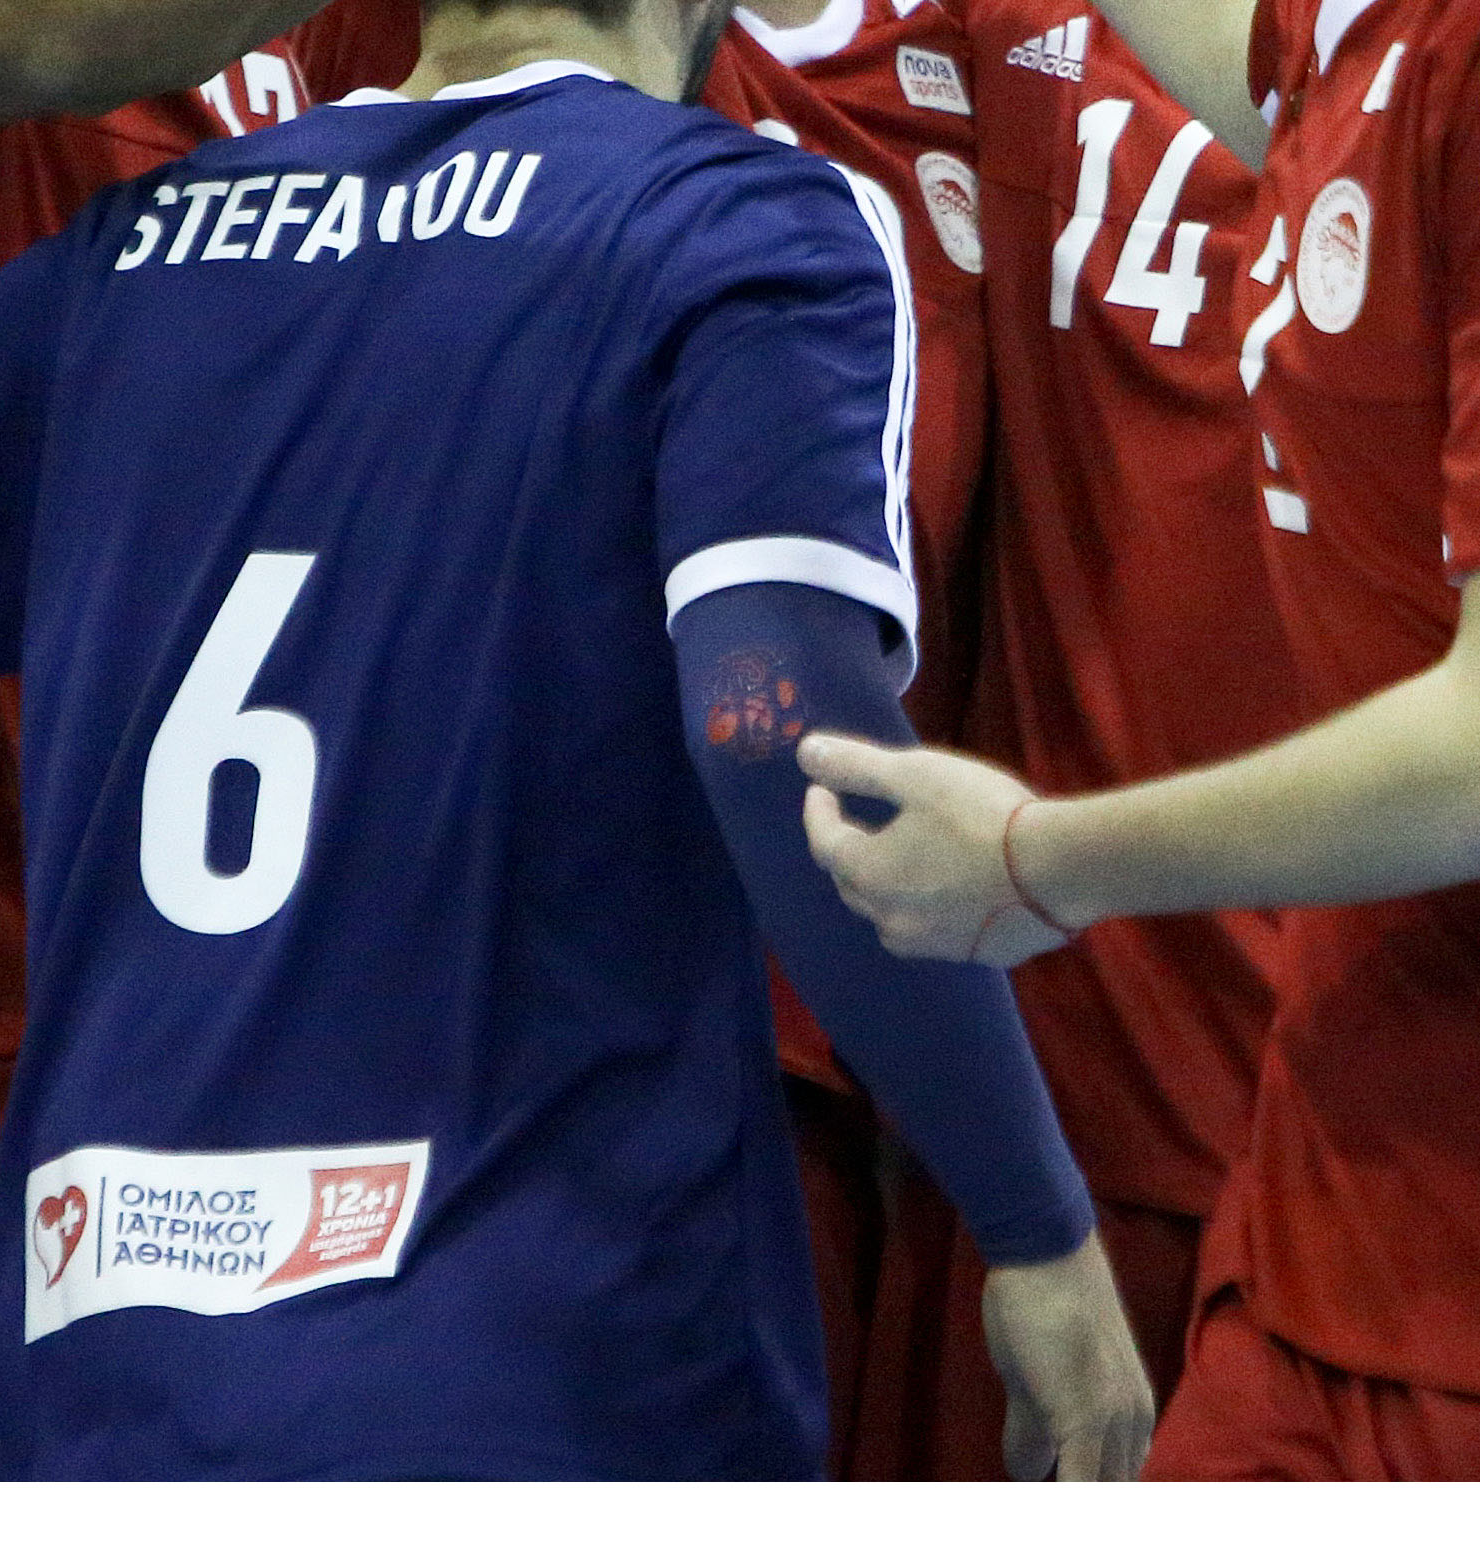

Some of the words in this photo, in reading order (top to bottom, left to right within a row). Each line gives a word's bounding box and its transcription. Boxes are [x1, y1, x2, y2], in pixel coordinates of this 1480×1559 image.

[904, 53, 953, 80] nova
[1006, 45, 1084, 83] adidas
[1049, 98, 1215, 348] 14
[139, 551, 319, 935] 6
[118, 1183, 258, 1216] ΟΜΙΛΟΣ
[319, 1181, 398, 1220] 12+1
[115, 1211, 274, 1246] ΙΑΤΡΙΚΟΥ
[111, 1240, 267, 1277] ΑΘΗΝΩΝ
